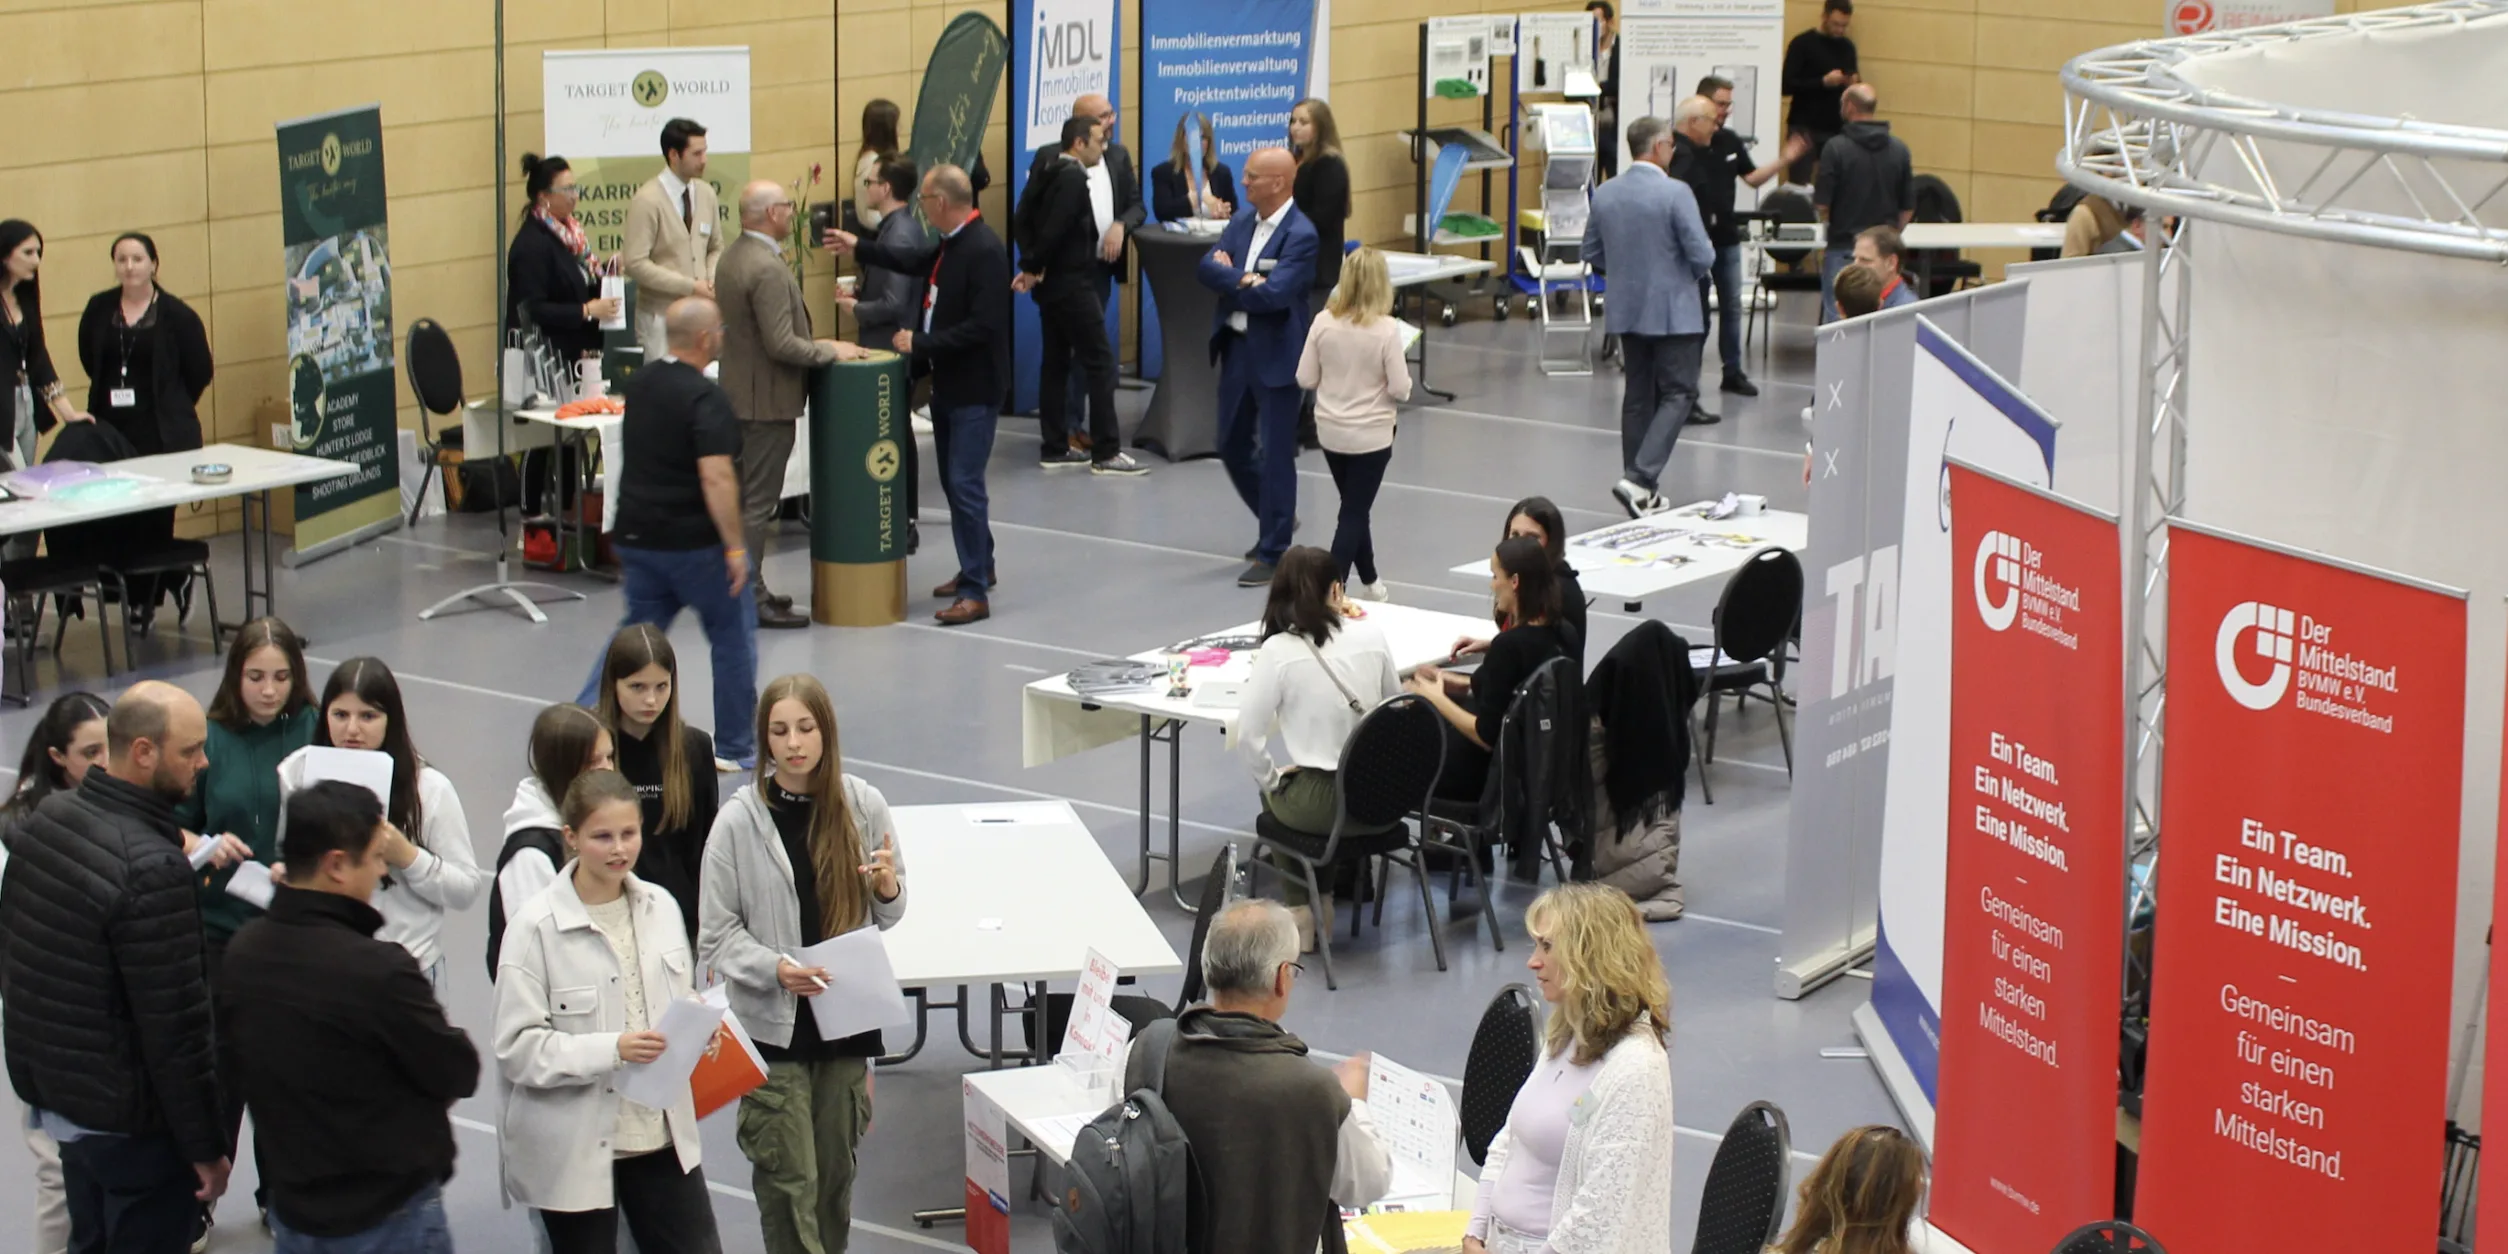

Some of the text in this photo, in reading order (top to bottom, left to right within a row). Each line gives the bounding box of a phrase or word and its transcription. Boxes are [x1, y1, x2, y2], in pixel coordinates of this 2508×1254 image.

[1152, 30, 1301, 50] Immobilienvermarktung
[1158, 56, 1298, 77] Immobilienverwaltung
[565, 80, 730, 98] TARGET WORLD
[1174, 83, 1295, 106] Projektentwicklung
[1212, 110, 1291, 128] Finanzierung
[288, 138, 373, 171] TARGET WORLD
[327, 393, 359, 413] ACADEMY
[332, 414, 355, 433] STORE
[351, 427, 373, 445] LODGE
[312, 465, 381, 500] SHOOTING GROUNDS
[878, 373, 892, 552] TARGET WORLD
[2023, 542, 2042, 568] Der
[2023, 567, 2080, 611] Mittelstand.
[2023, 593, 2048, 616] BVMW
[2022, 611, 2078, 650] Bundesverband
[2301, 615, 2332, 644] Der
[2299, 670, 2366, 704] BVMW e.V.
[2300, 643, 2398, 693] Mittelstand.
[2297, 690, 2392, 733] Bundesverband
[1991, 731, 2058, 785] Ein Team.
[1975, 765, 2070, 833] Ein Netzwerk.
[1976, 805, 2068, 872] Eine Mission.
[2241, 818, 2353, 878] Ein Team.
[2215, 853, 2372, 929] Ein Netzwerk.
[1980, 886, 2064, 950] Gemeinsam
[2215, 896, 2367, 972] Eine Mission.
[1992, 929, 2051, 983] für einen
[1994, 976, 2045, 1020] starken
[2220, 984, 2355, 1054] Gemeinsam
[1980, 1002, 2060, 1068] Mittelstand.
[2237, 1030, 2334, 1090] für einen
[2241, 1081, 2324, 1130] starken
[2215, 1108, 2345, 1181] Mittelstand.
